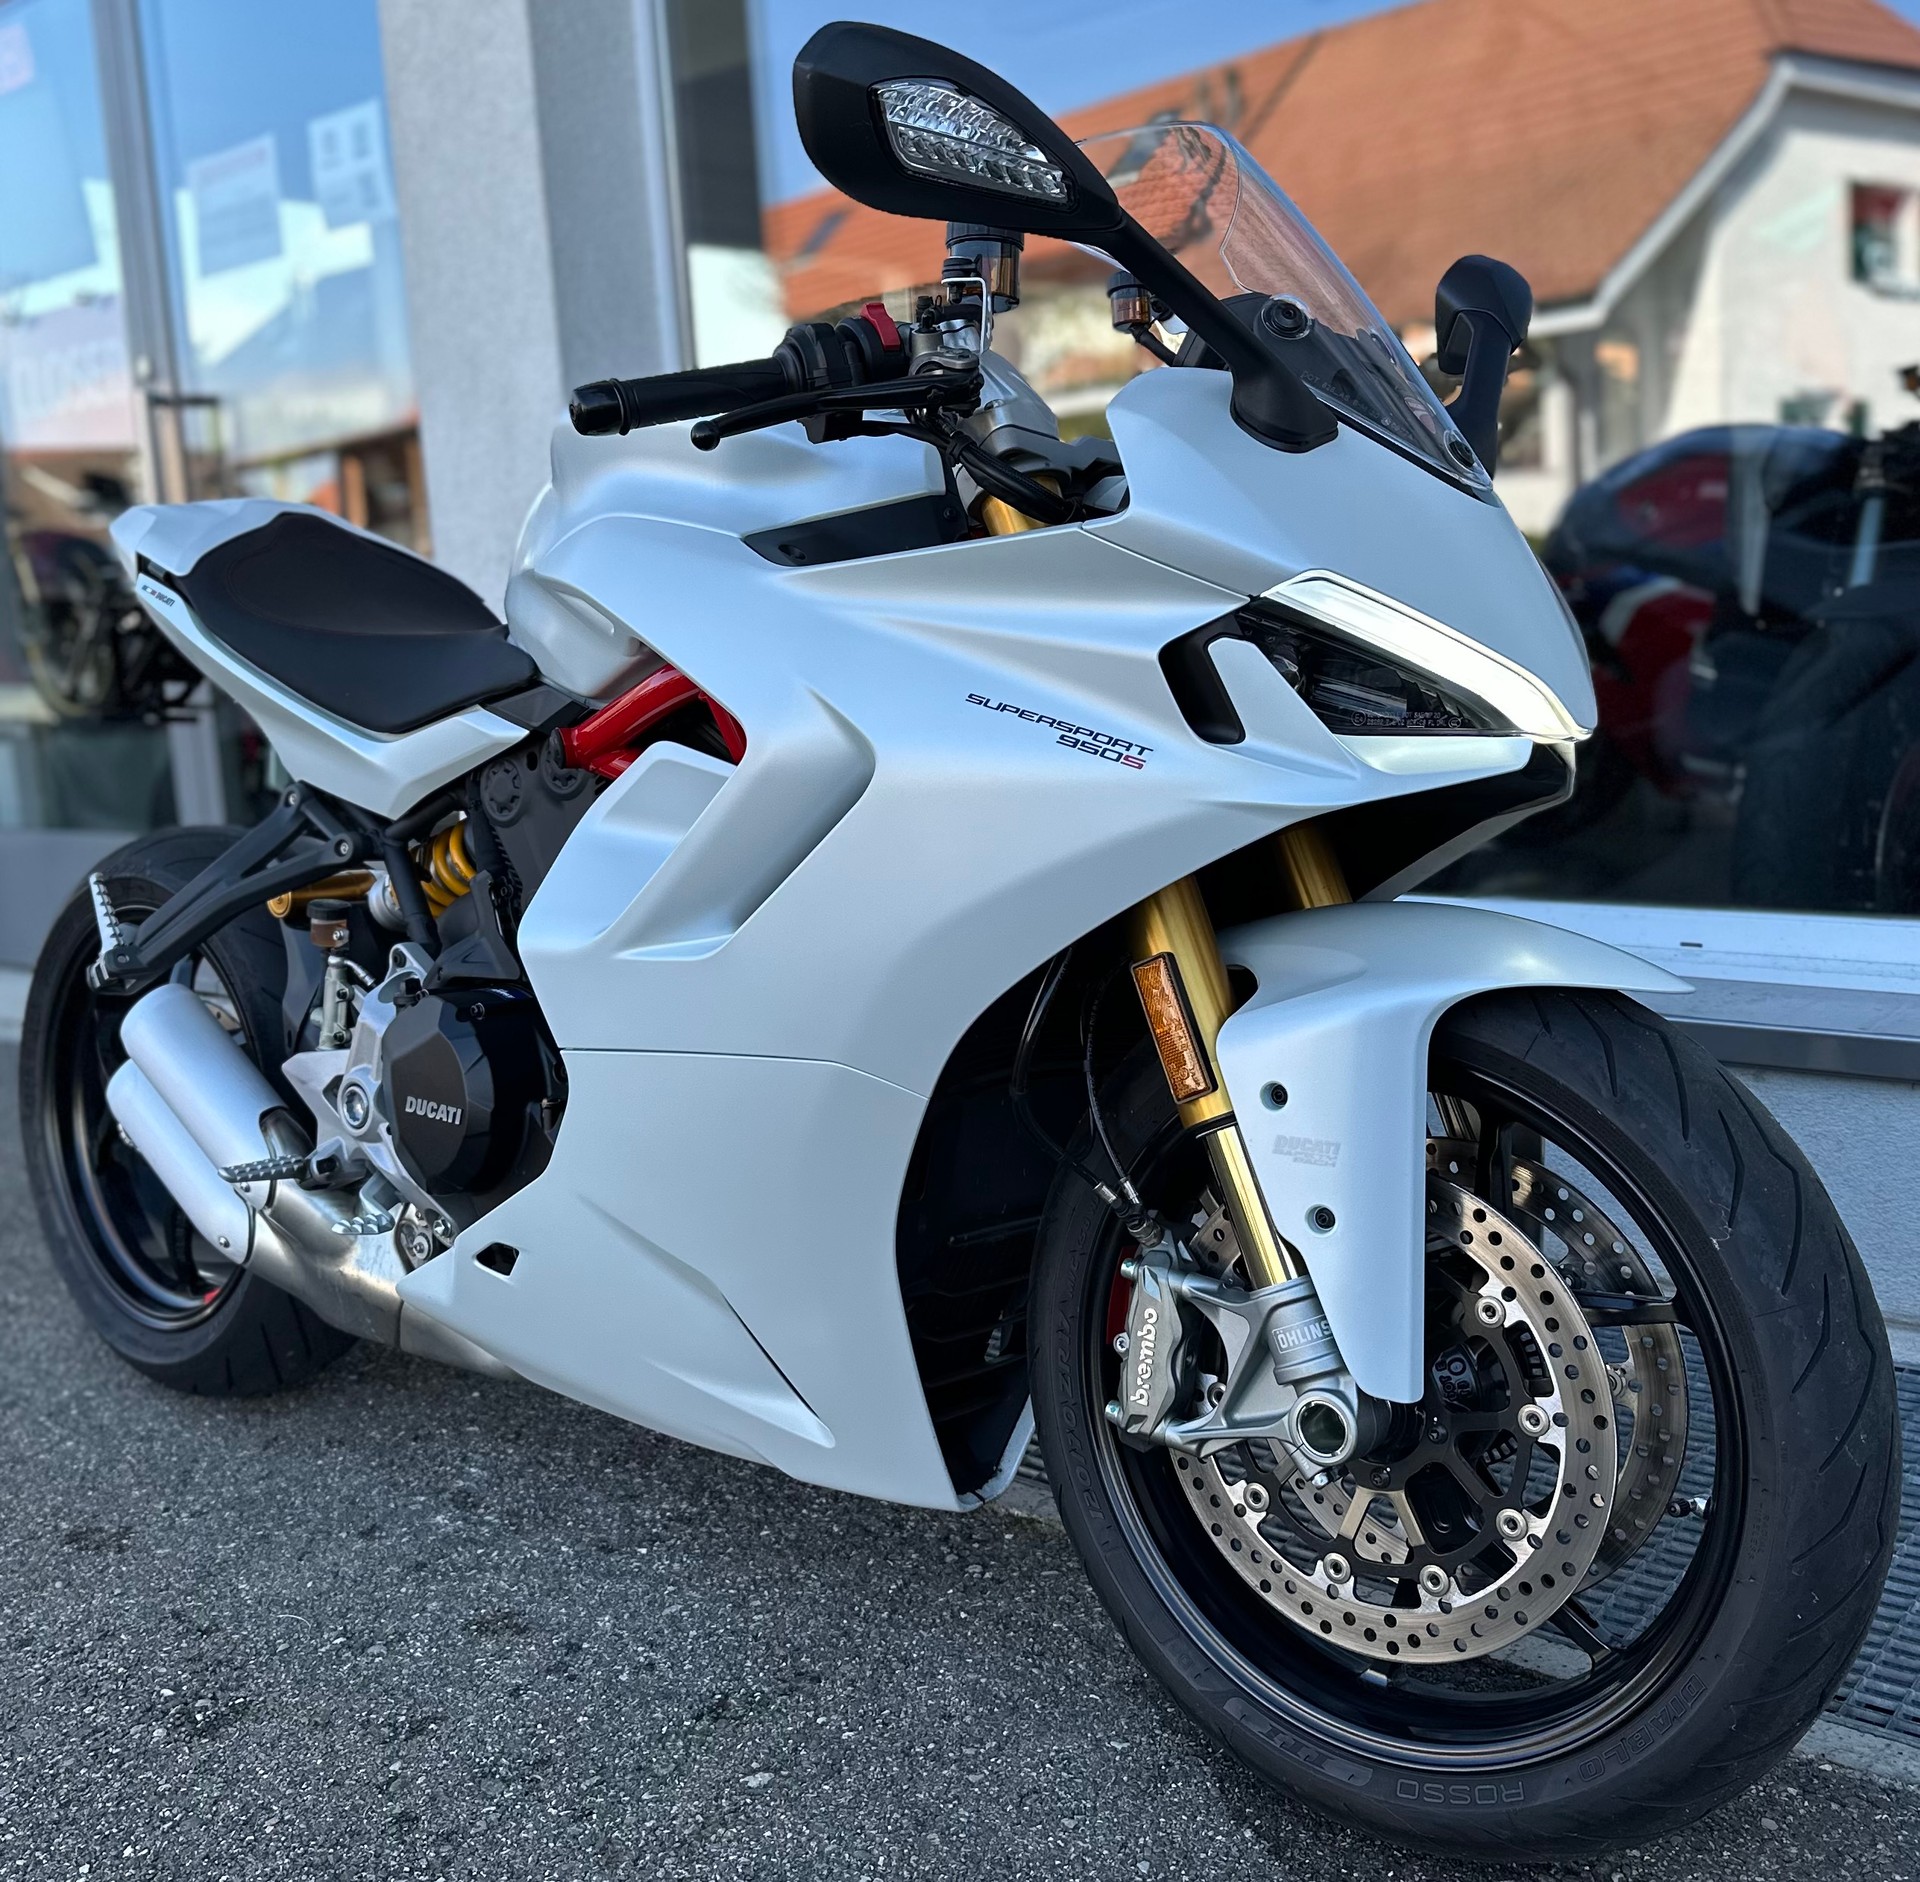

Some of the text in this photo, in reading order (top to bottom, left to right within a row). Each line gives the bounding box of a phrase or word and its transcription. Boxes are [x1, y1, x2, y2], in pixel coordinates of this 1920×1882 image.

[965, 693, 1154, 756] SUPERSPORT
[1056, 734, 1146, 770] 950S
[405, 1096, 462, 1125] DUCATI
[1274, 1134, 1341, 1155] DUCATI
[1278, 1320, 1333, 1350] ÖHLINS
[1130, 1307, 1159, 1406] brembo
[1578, 1673, 1708, 1782] DIABLO
[1396, 1778, 1525, 1805] ROSSO
